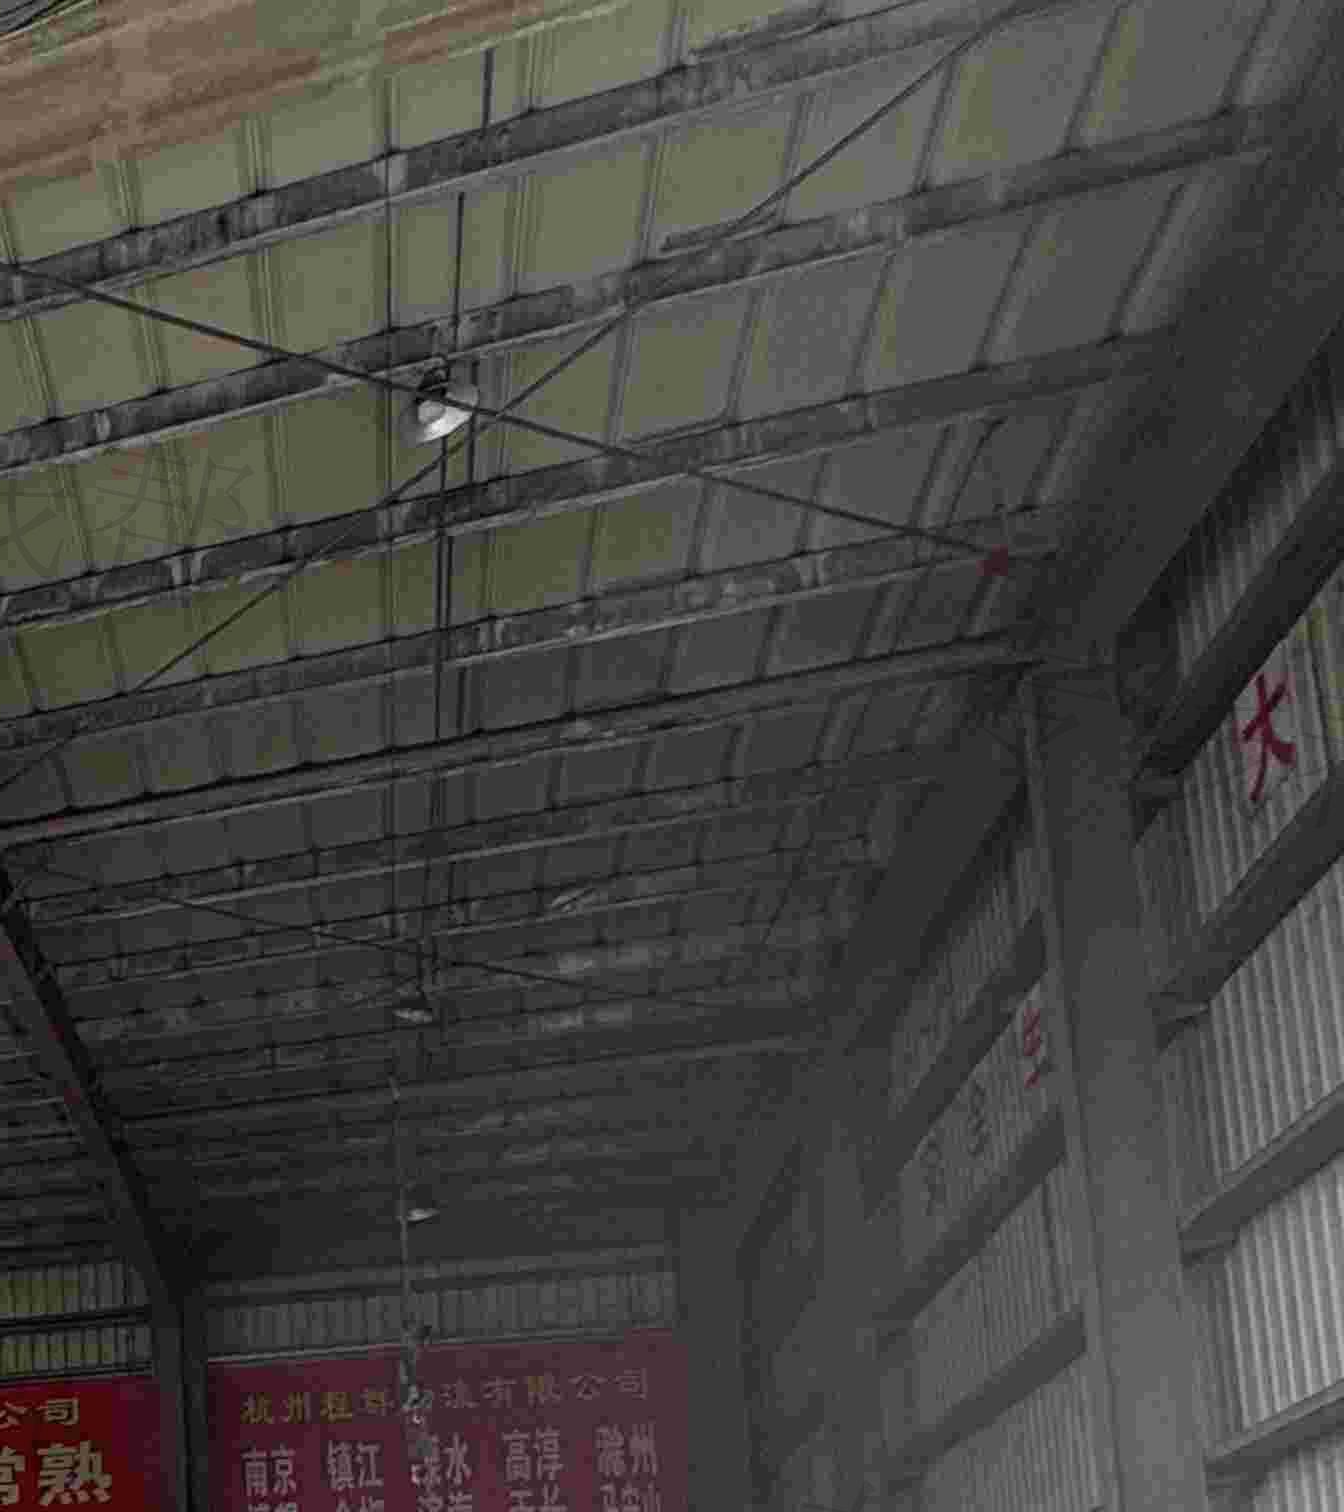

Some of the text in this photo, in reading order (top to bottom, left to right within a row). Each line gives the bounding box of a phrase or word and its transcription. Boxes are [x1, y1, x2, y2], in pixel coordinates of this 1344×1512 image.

[240, 1444, 298, 1497] 南京
[326, 1440, 384, 1492] 镇江
[502, 1427, 564, 1482] 高淳
